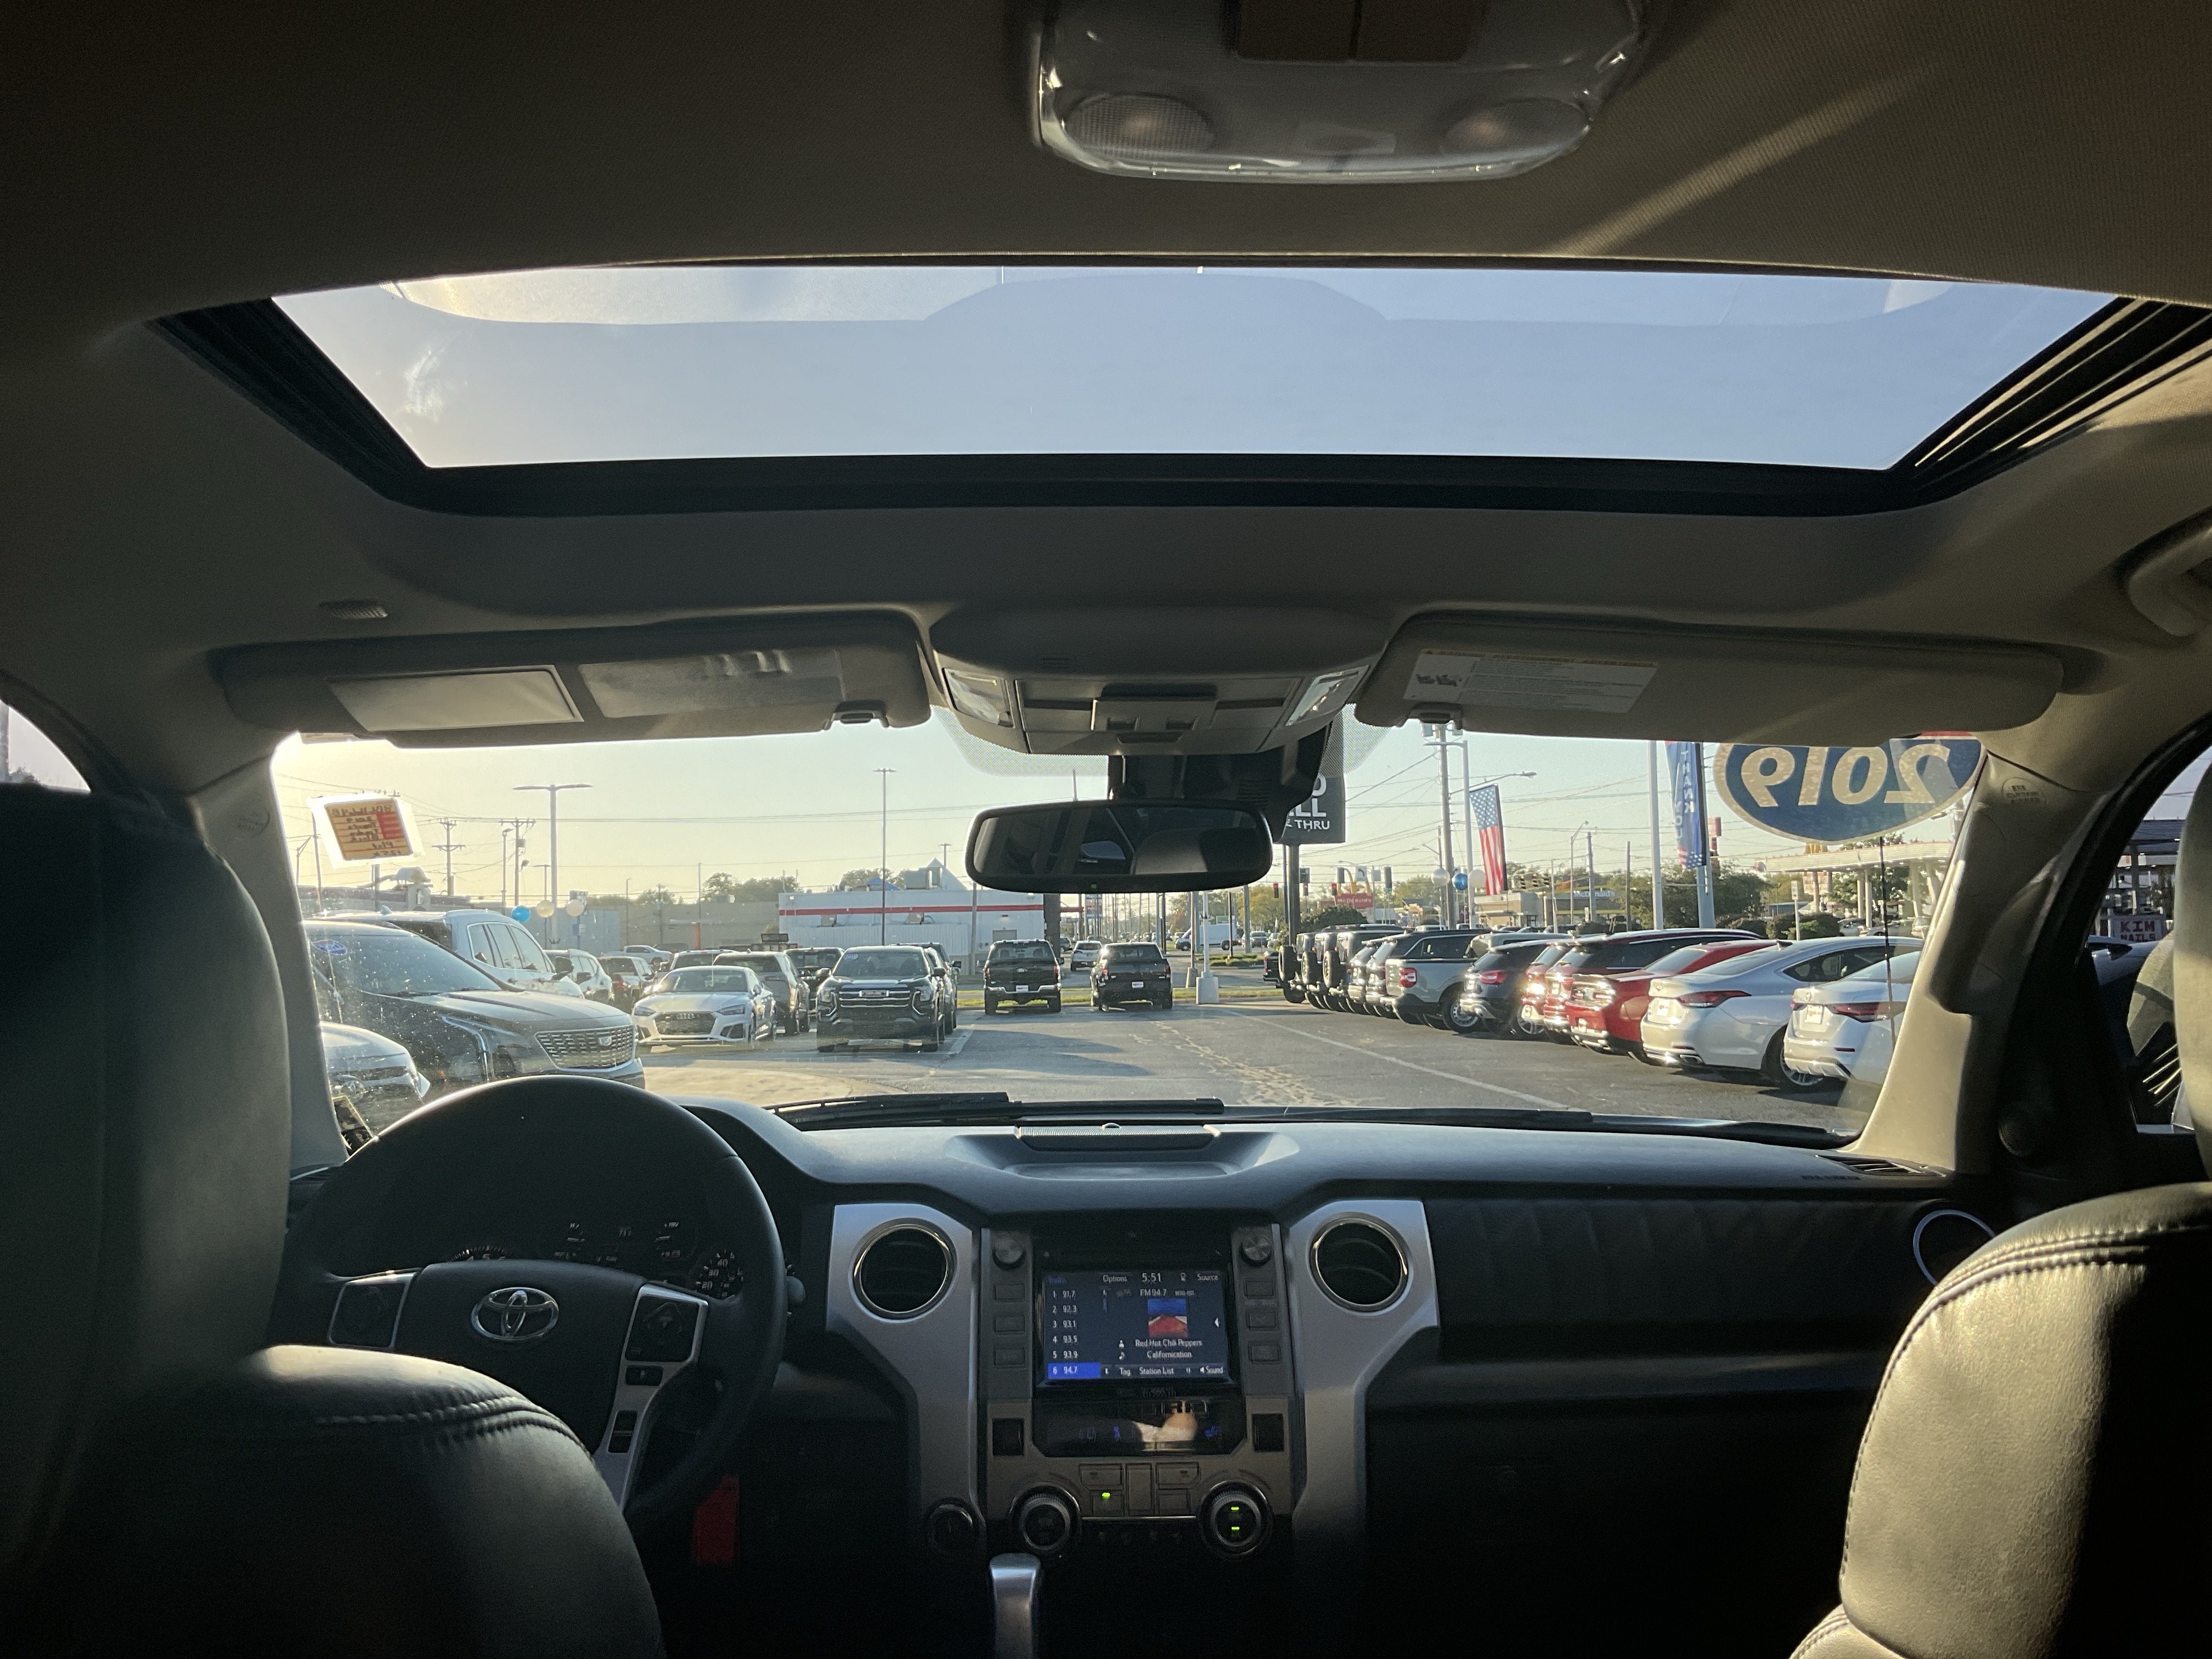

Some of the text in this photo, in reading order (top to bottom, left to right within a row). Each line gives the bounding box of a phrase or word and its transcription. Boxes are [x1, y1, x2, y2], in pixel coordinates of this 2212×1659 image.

[1294, 819, 1330, 830] THRU
[2120, 921, 2155, 932] KIM
[1142, 1273, 1162, 1282] 5:51
[1178, 1339, 1202, 1347] Peppers
[1063, 1365, 1078, 1374] 94.7
[1120, 1368, 1131, 1376] Tag
